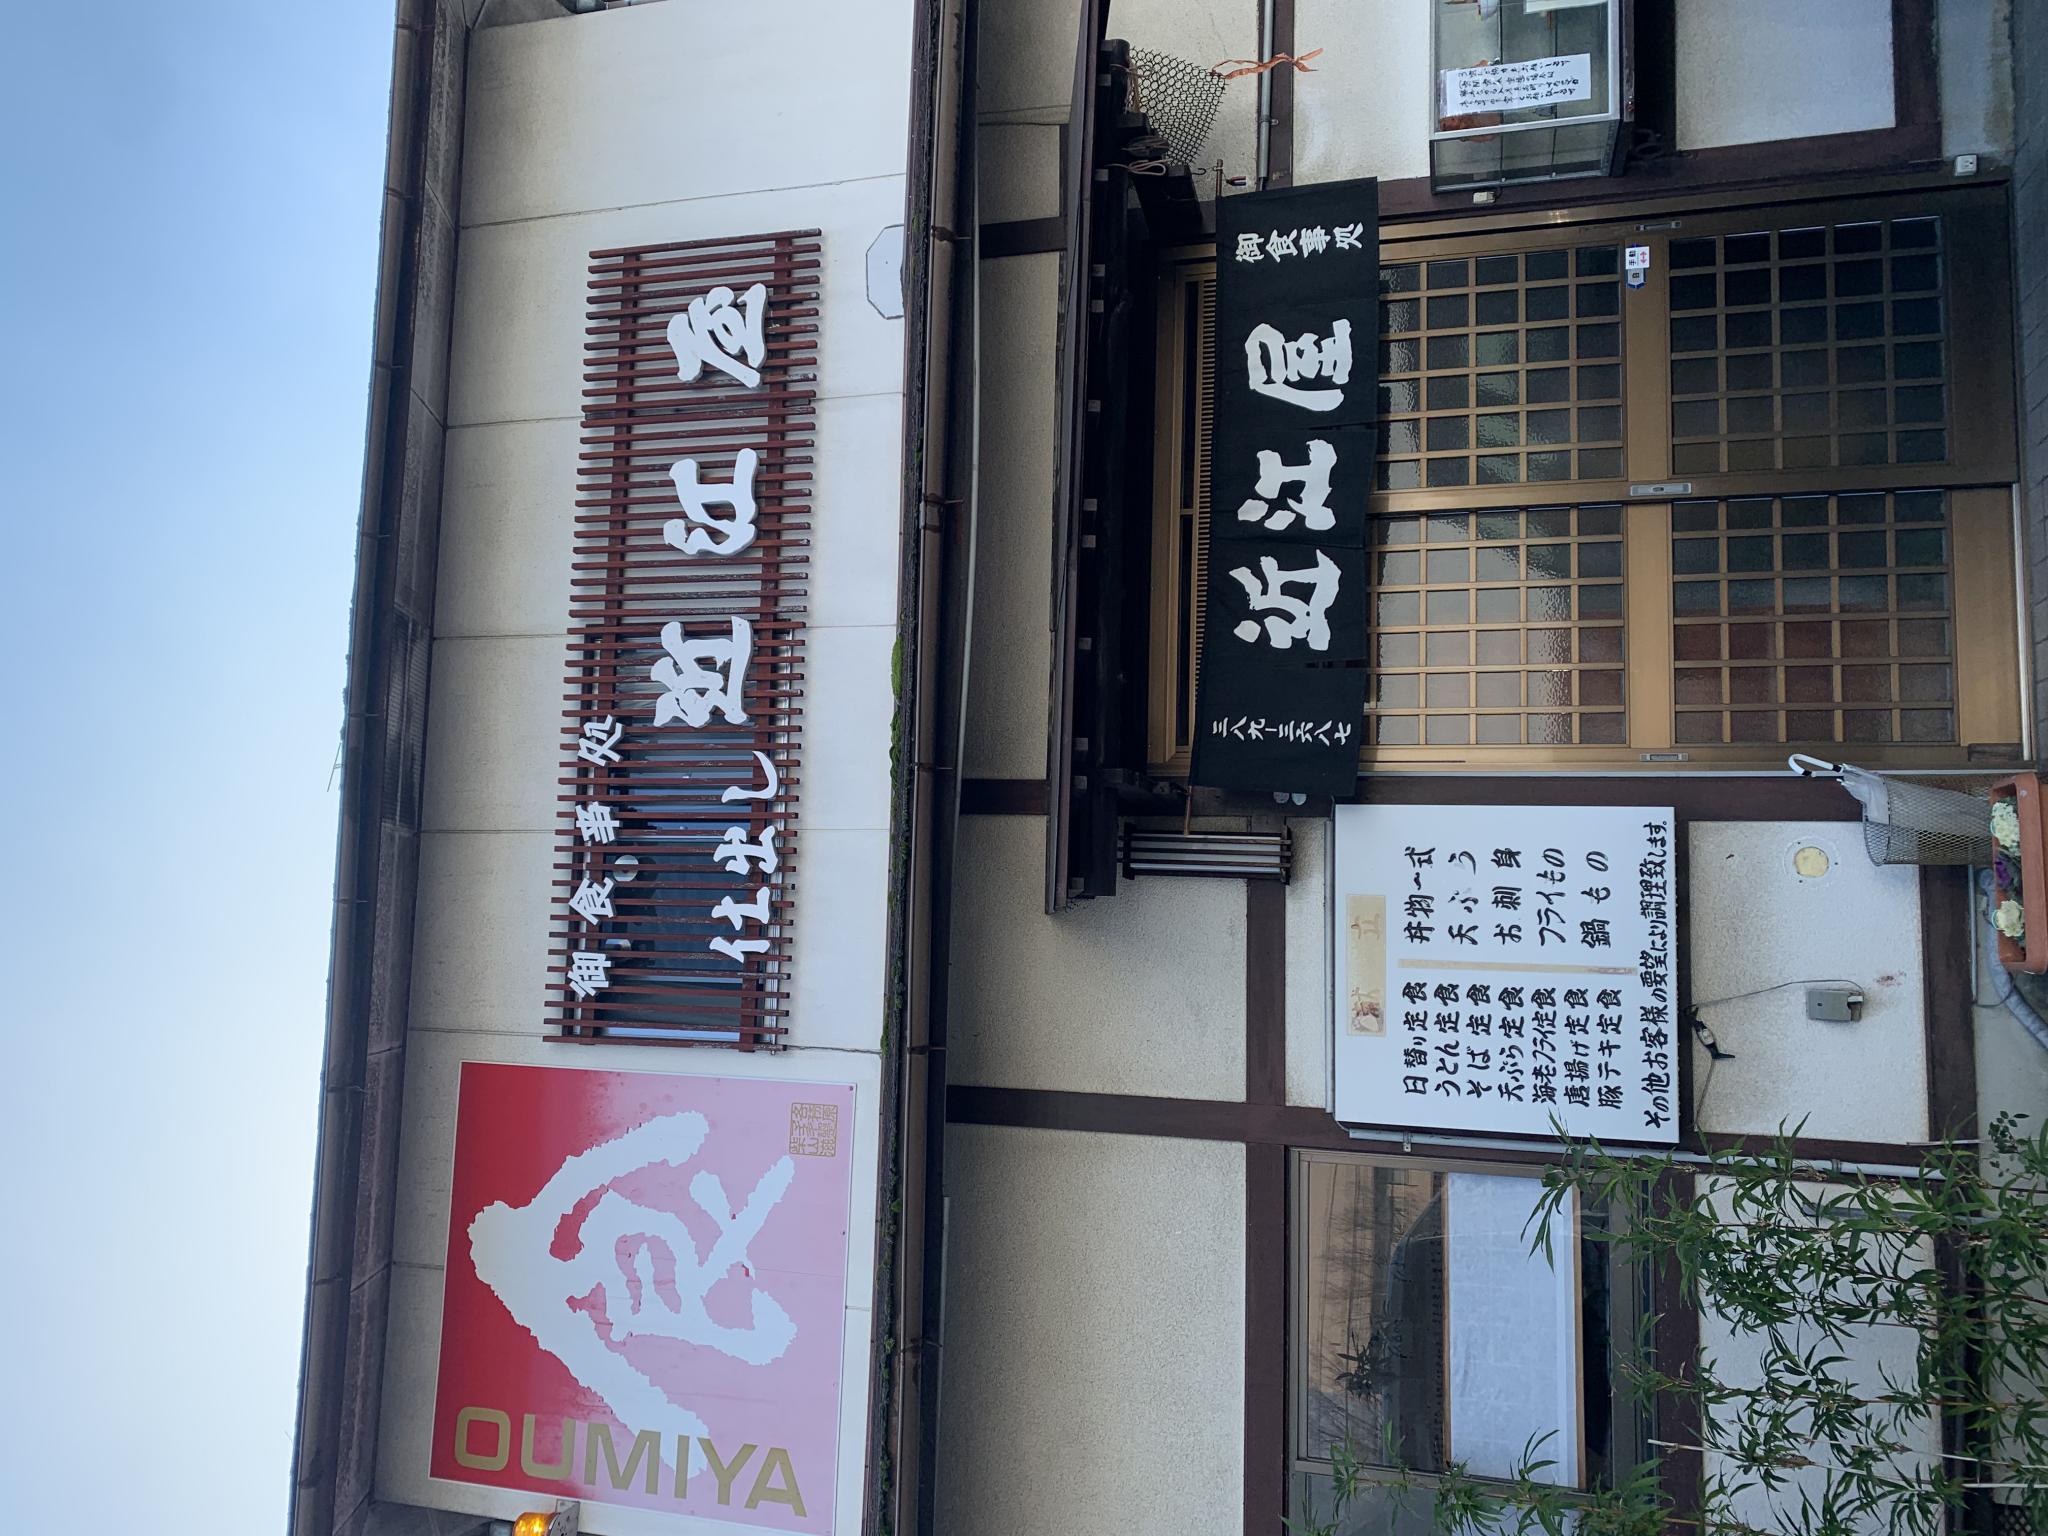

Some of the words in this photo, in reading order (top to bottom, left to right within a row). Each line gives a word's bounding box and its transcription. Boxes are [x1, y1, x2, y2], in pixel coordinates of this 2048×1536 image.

[1234, 222, 1364, 264] 御食事処
[650, 283, 769, 728] 近江屋
[1228, 319, 1352, 651] 近江屋
[567, 715, 625, 998] 御食事処
[709, 750, 779, 963] 仕出し
[1403, 846, 1436, 944] 丼物一式
[1490, 847, 1522, 945] お刺身
[1536, 847, 1566, 947] フライもの
[1580, 850, 1611, 949] 鍋もの
[1402, 981, 1429, 1095] 日替り定食
[1466, 983, 1493, 1098] そば定食
[1497, 986, 1525, 1102] 天ぷら定食
[1531, 987, 1557, 1105] 海老フライ定食
[1563, 987, 1590, 1107] 唐揚げ定食
[1596, 989, 1623, 1109] 豚テキ定食
[466, 1111, 797, 1480] 食
[453, 1406, 807, 1517] OUMIYA
